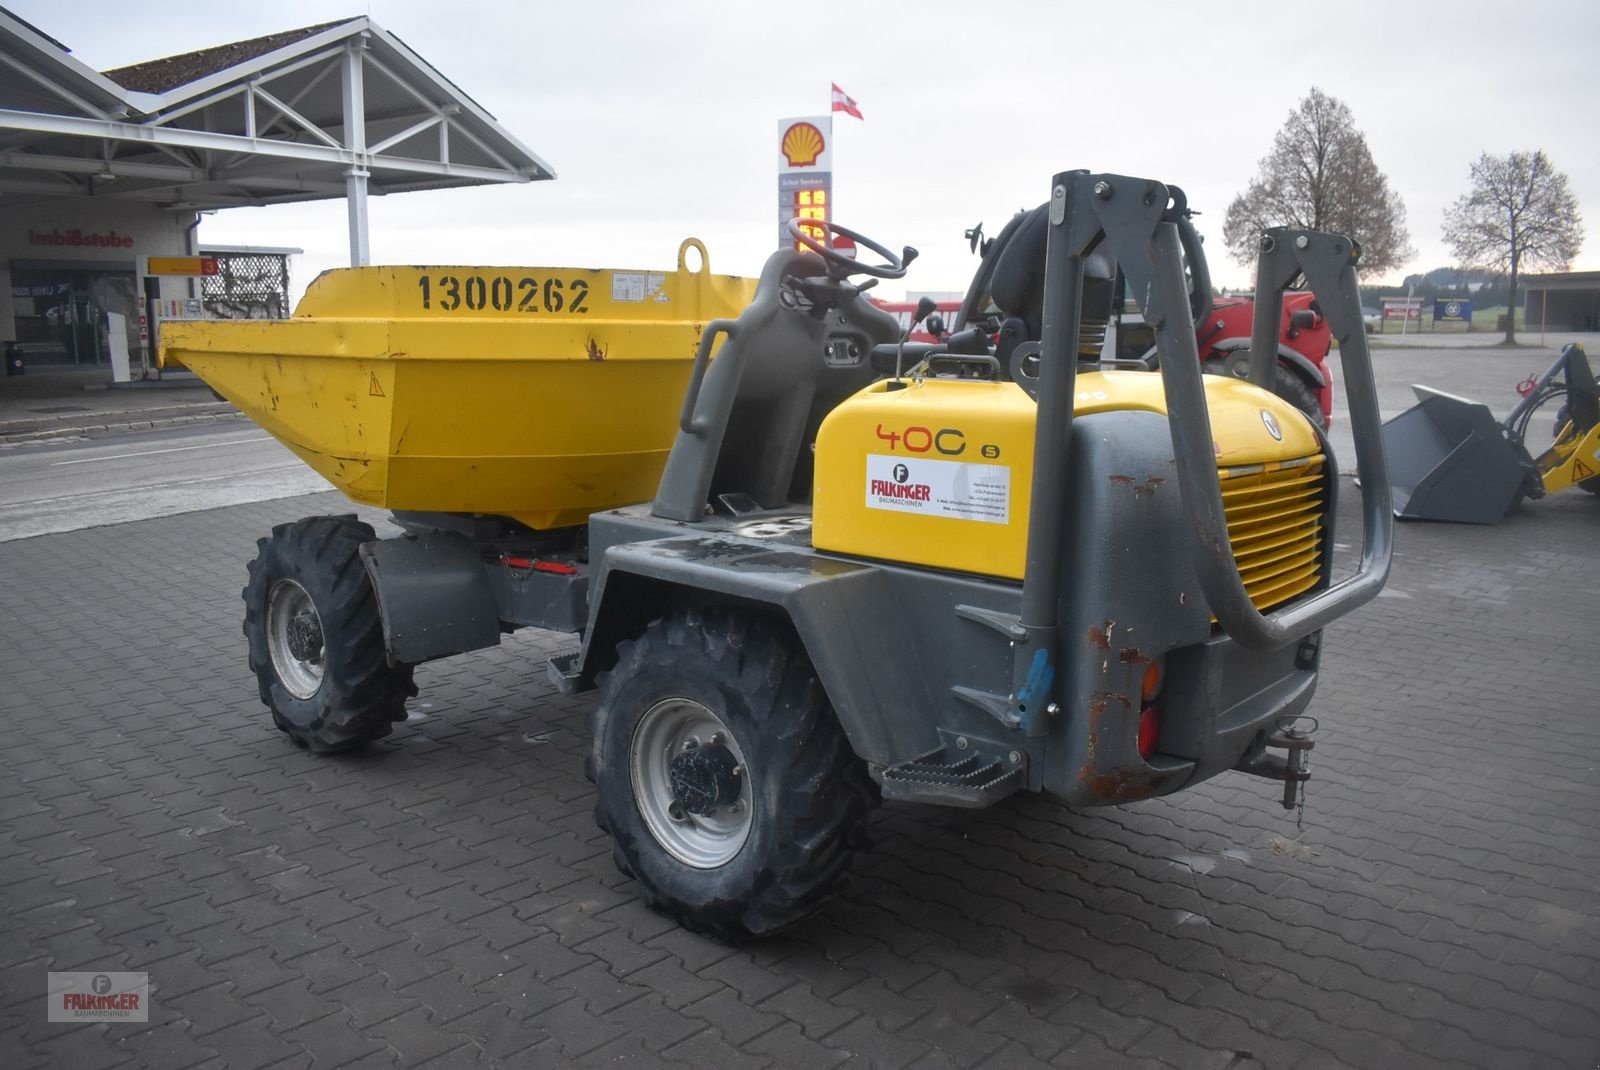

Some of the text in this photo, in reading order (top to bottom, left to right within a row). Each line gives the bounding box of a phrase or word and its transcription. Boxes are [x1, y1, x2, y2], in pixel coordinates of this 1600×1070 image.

[28, 228, 134, 248] Imbißstube
[206, 261, 215, 274] 3
[419, 275, 589, 313] 1300262
[871, 479, 931, 501] FALKINGER
[879, 497, 923, 507] BAUMASCHINEN
